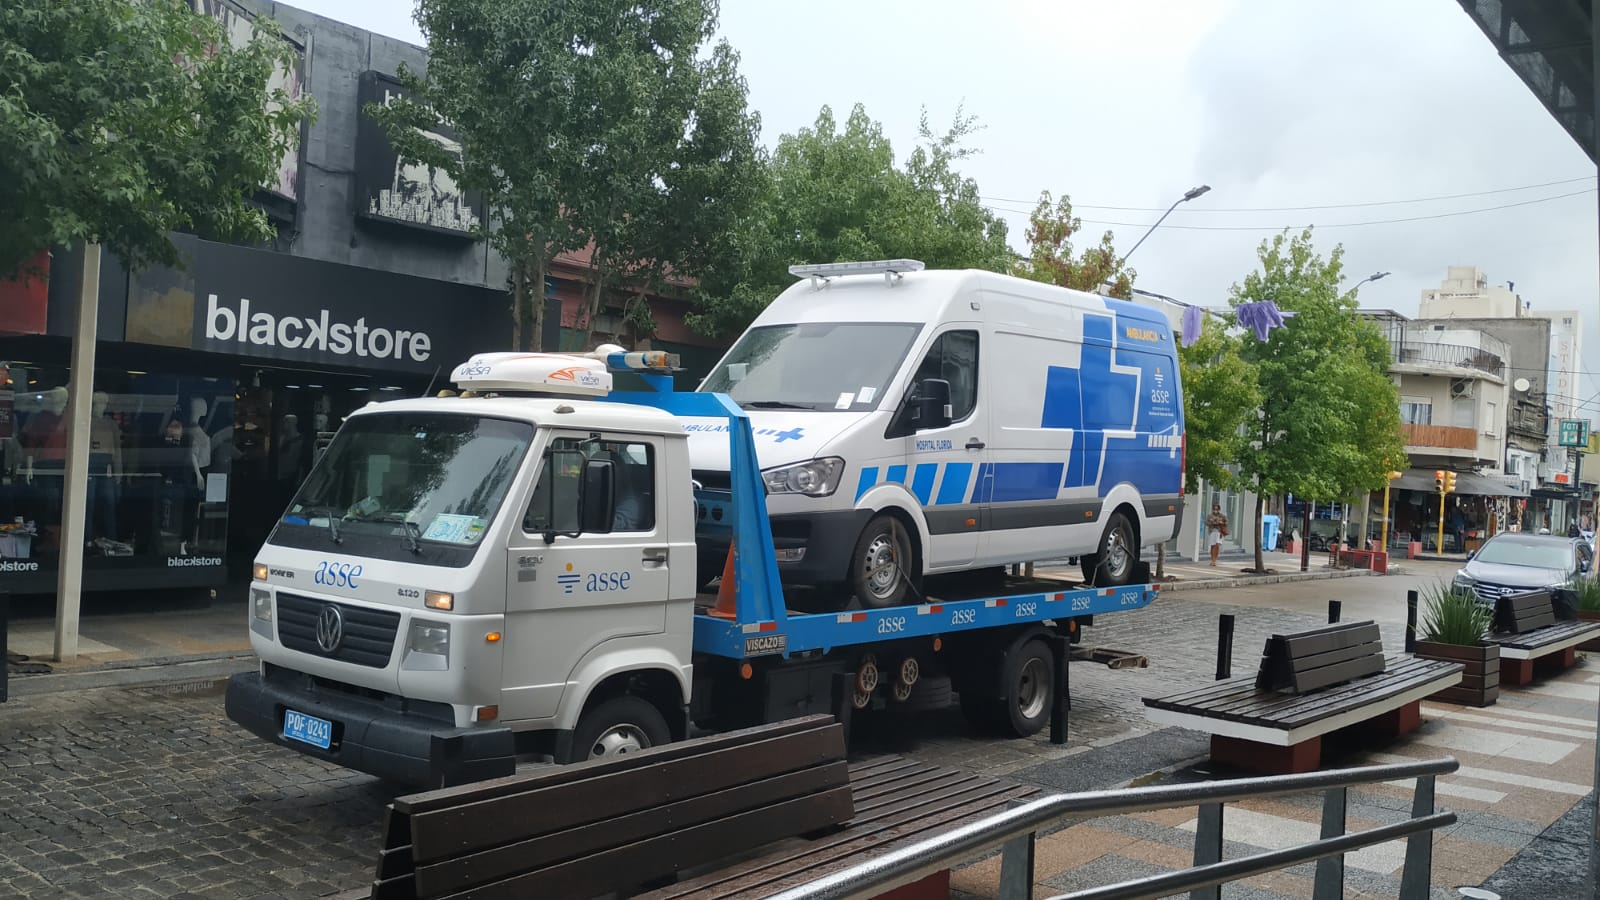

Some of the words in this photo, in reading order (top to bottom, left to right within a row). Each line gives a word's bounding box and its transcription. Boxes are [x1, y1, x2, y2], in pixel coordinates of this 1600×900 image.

[205, 293, 432, 363] blackstore
[460, 366, 491, 376] VIESA
[1151, 389, 1170, 404] asse
[916, 440, 936, 451] HOSPITAL
[936, 439, 953, 450] FLORIDA
[167, 556, 222, 567] blackstore
[314, 560, 364, 589] asse
[586, 570, 631, 592] asse
[1071, 595, 1091, 611] asse
[1120, 591, 1138, 605] asse
[951, 608, 976, 625] asse
[1015, 601, 1037, 617] asse
[877, 615, 906, 634] asse
[746, 636, 778, 651] VISCAZO
